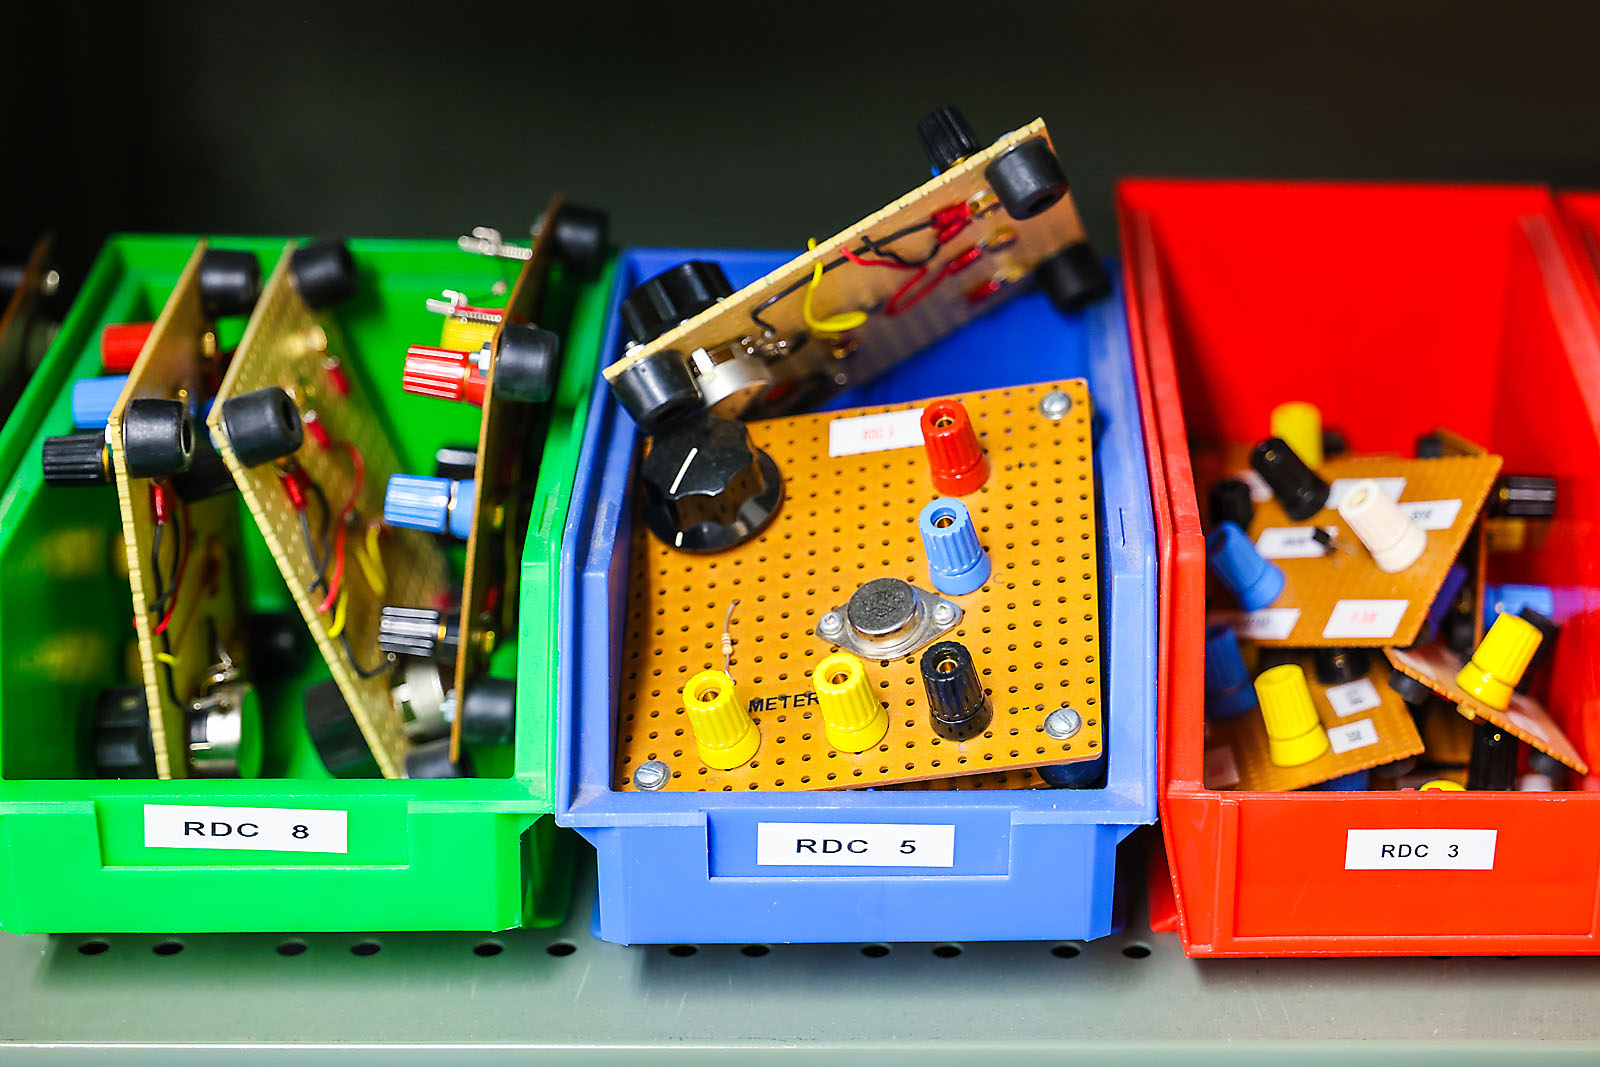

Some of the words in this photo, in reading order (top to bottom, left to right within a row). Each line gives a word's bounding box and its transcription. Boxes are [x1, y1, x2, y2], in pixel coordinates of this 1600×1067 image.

[748, 691, 820, 713] METER
[184, 821, 259, 838] RDC
[291, 824, 310, 840] 8
[796, 838, 869, 854] RDC
[899, 839, 916, 855] 5
[1381, 844, 1429, 858] RDC
[1447, 844, 1459, 858] 3
